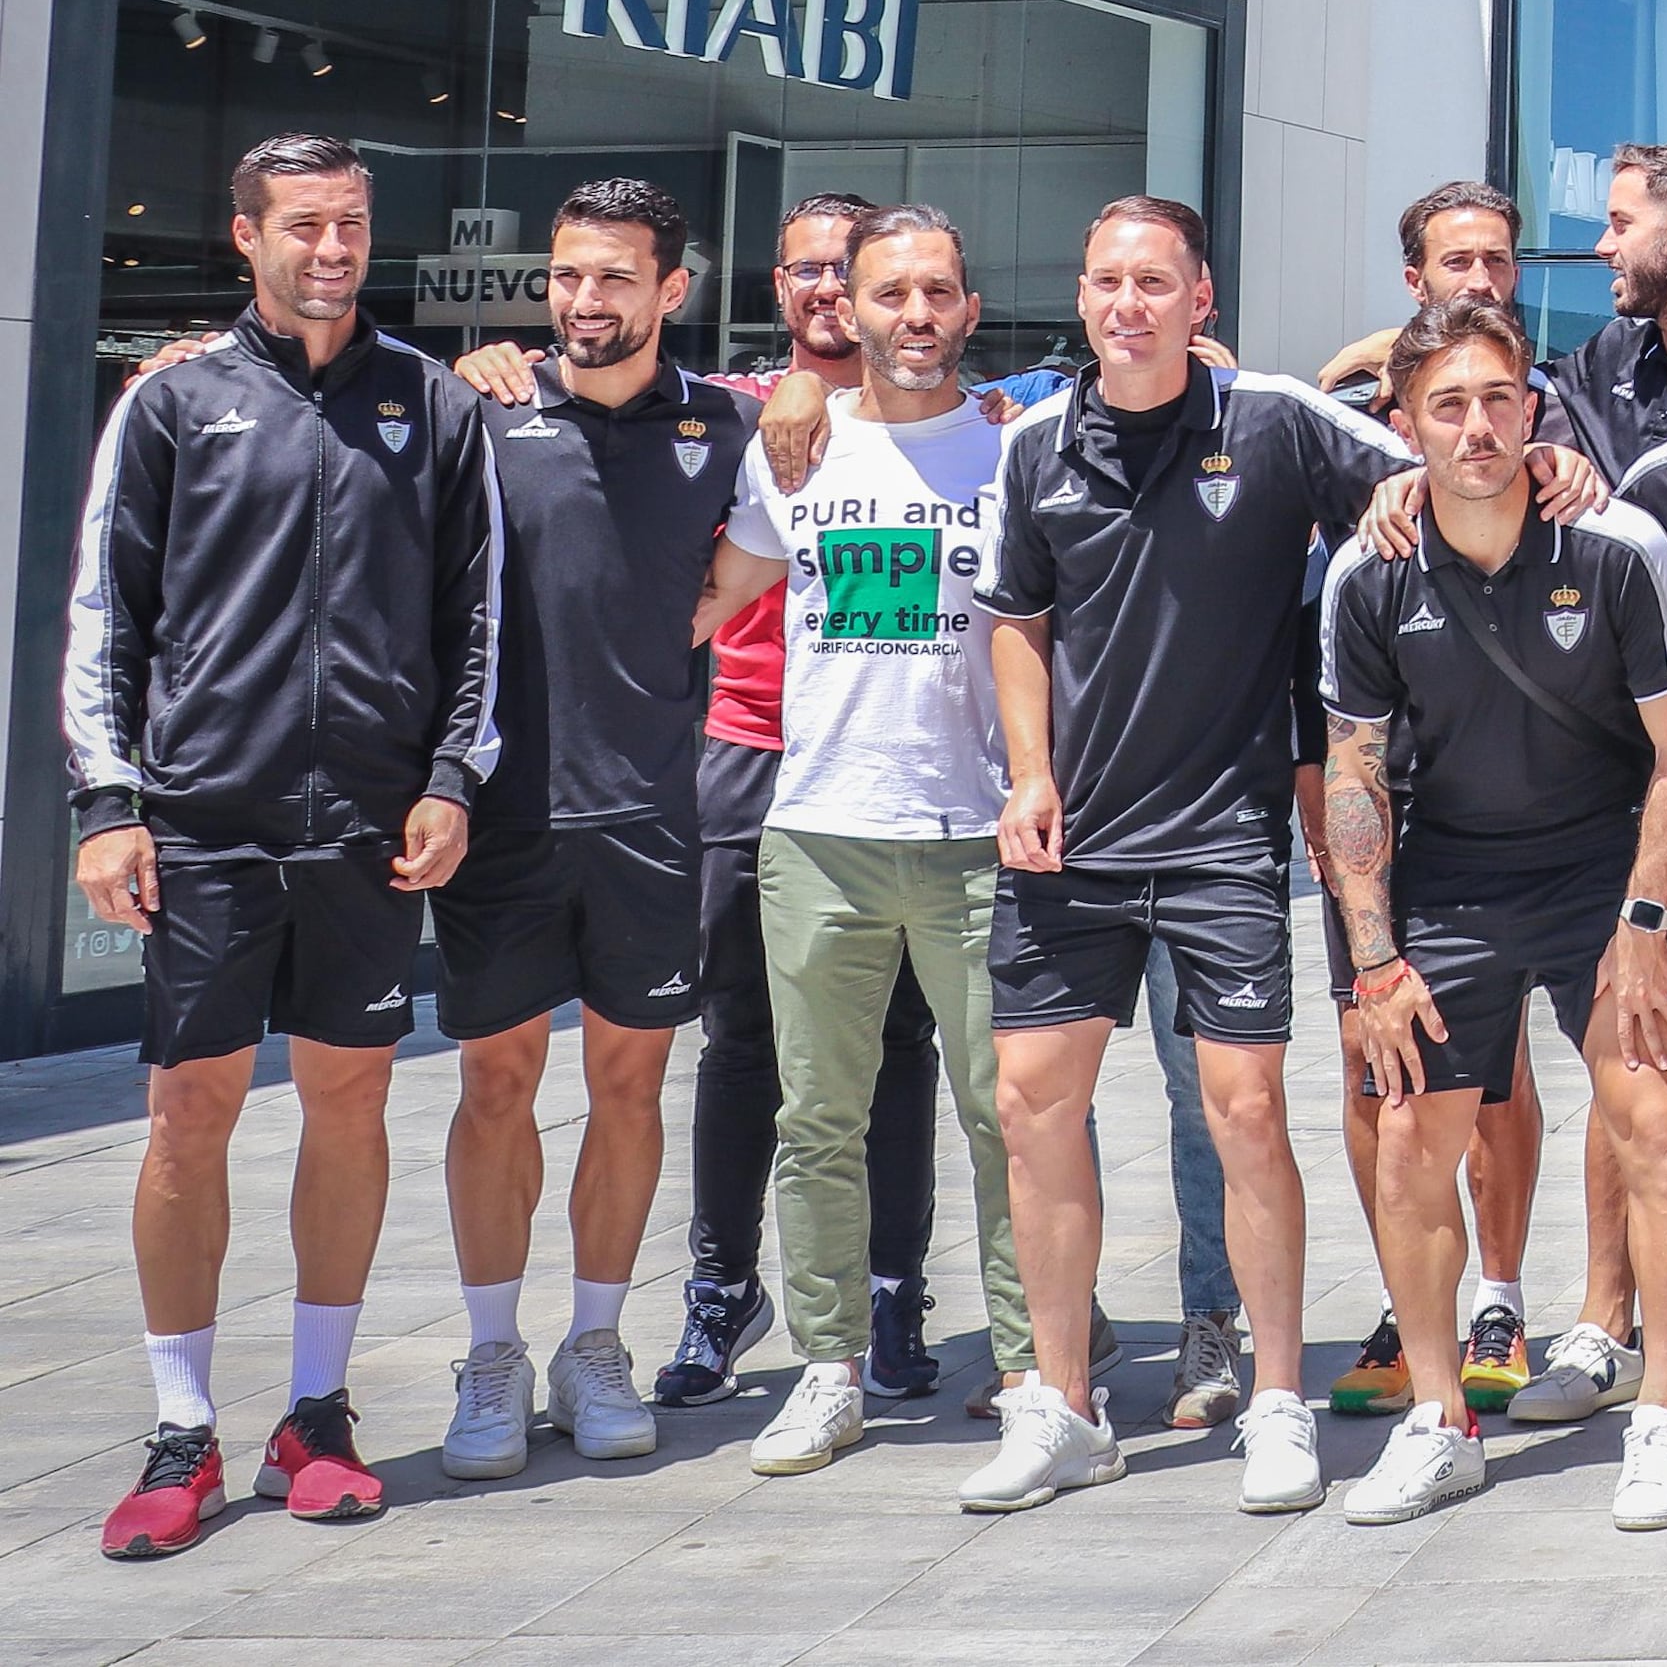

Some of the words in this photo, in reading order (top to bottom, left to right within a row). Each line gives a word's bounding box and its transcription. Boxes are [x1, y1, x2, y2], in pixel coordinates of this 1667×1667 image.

[453, 219, 493, 246] MI
[417, 268, 551, 303] NUEVO
[791, 499, 876, 531] PURI
[903, 497, 981, 530] and
[796, 528, 979, 588] simple
[805, 611, 882, 638] every
[895, 604, 970, 633] time
[1397, 617, 1446, 634] MERCURY
